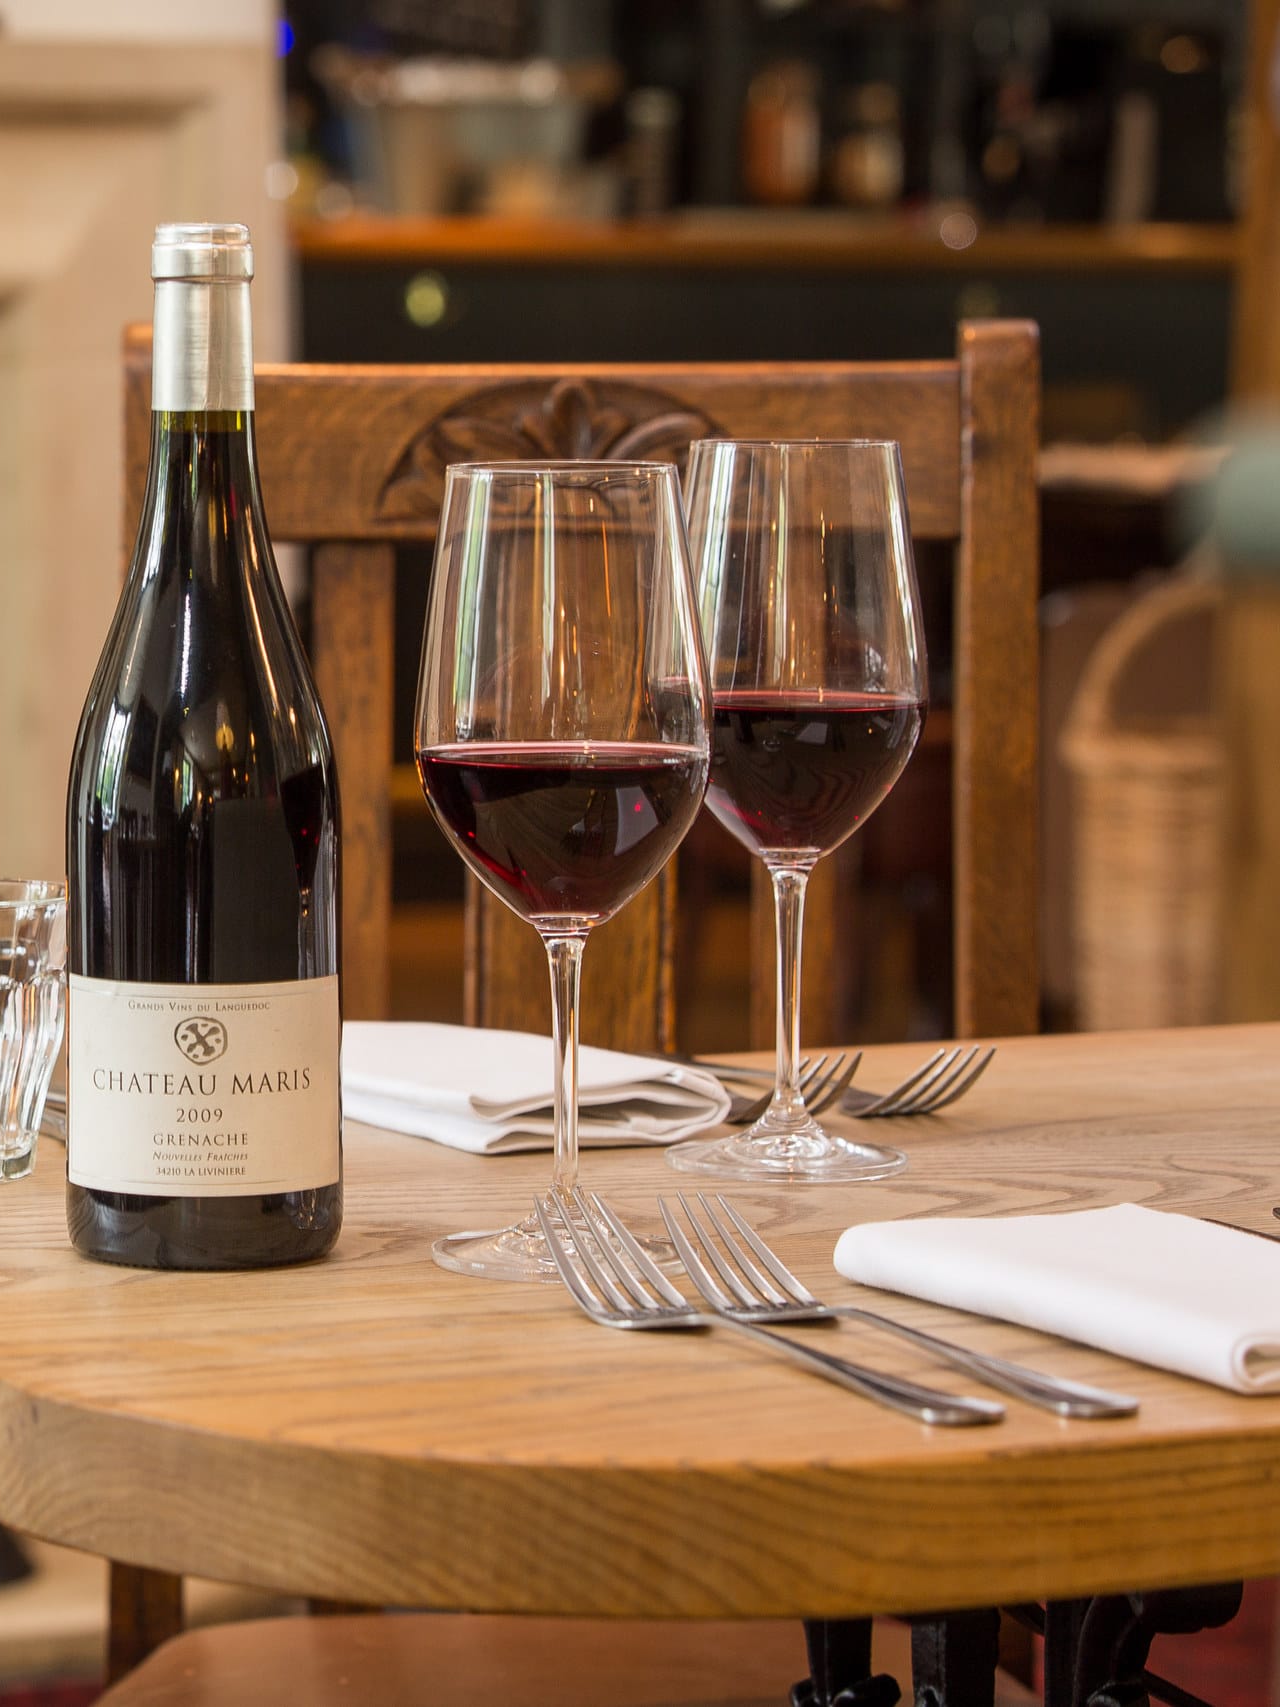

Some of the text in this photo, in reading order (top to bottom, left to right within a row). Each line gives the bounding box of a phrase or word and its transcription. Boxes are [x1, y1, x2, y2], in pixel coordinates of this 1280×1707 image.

[93, 1067, 311, 1096] CHATEAU MARIS
[176, 1108, 223, 1123] 2009
[153, 1133, 248, 1146] GRENACHE
[184, 1167, 195, 1176] LA
